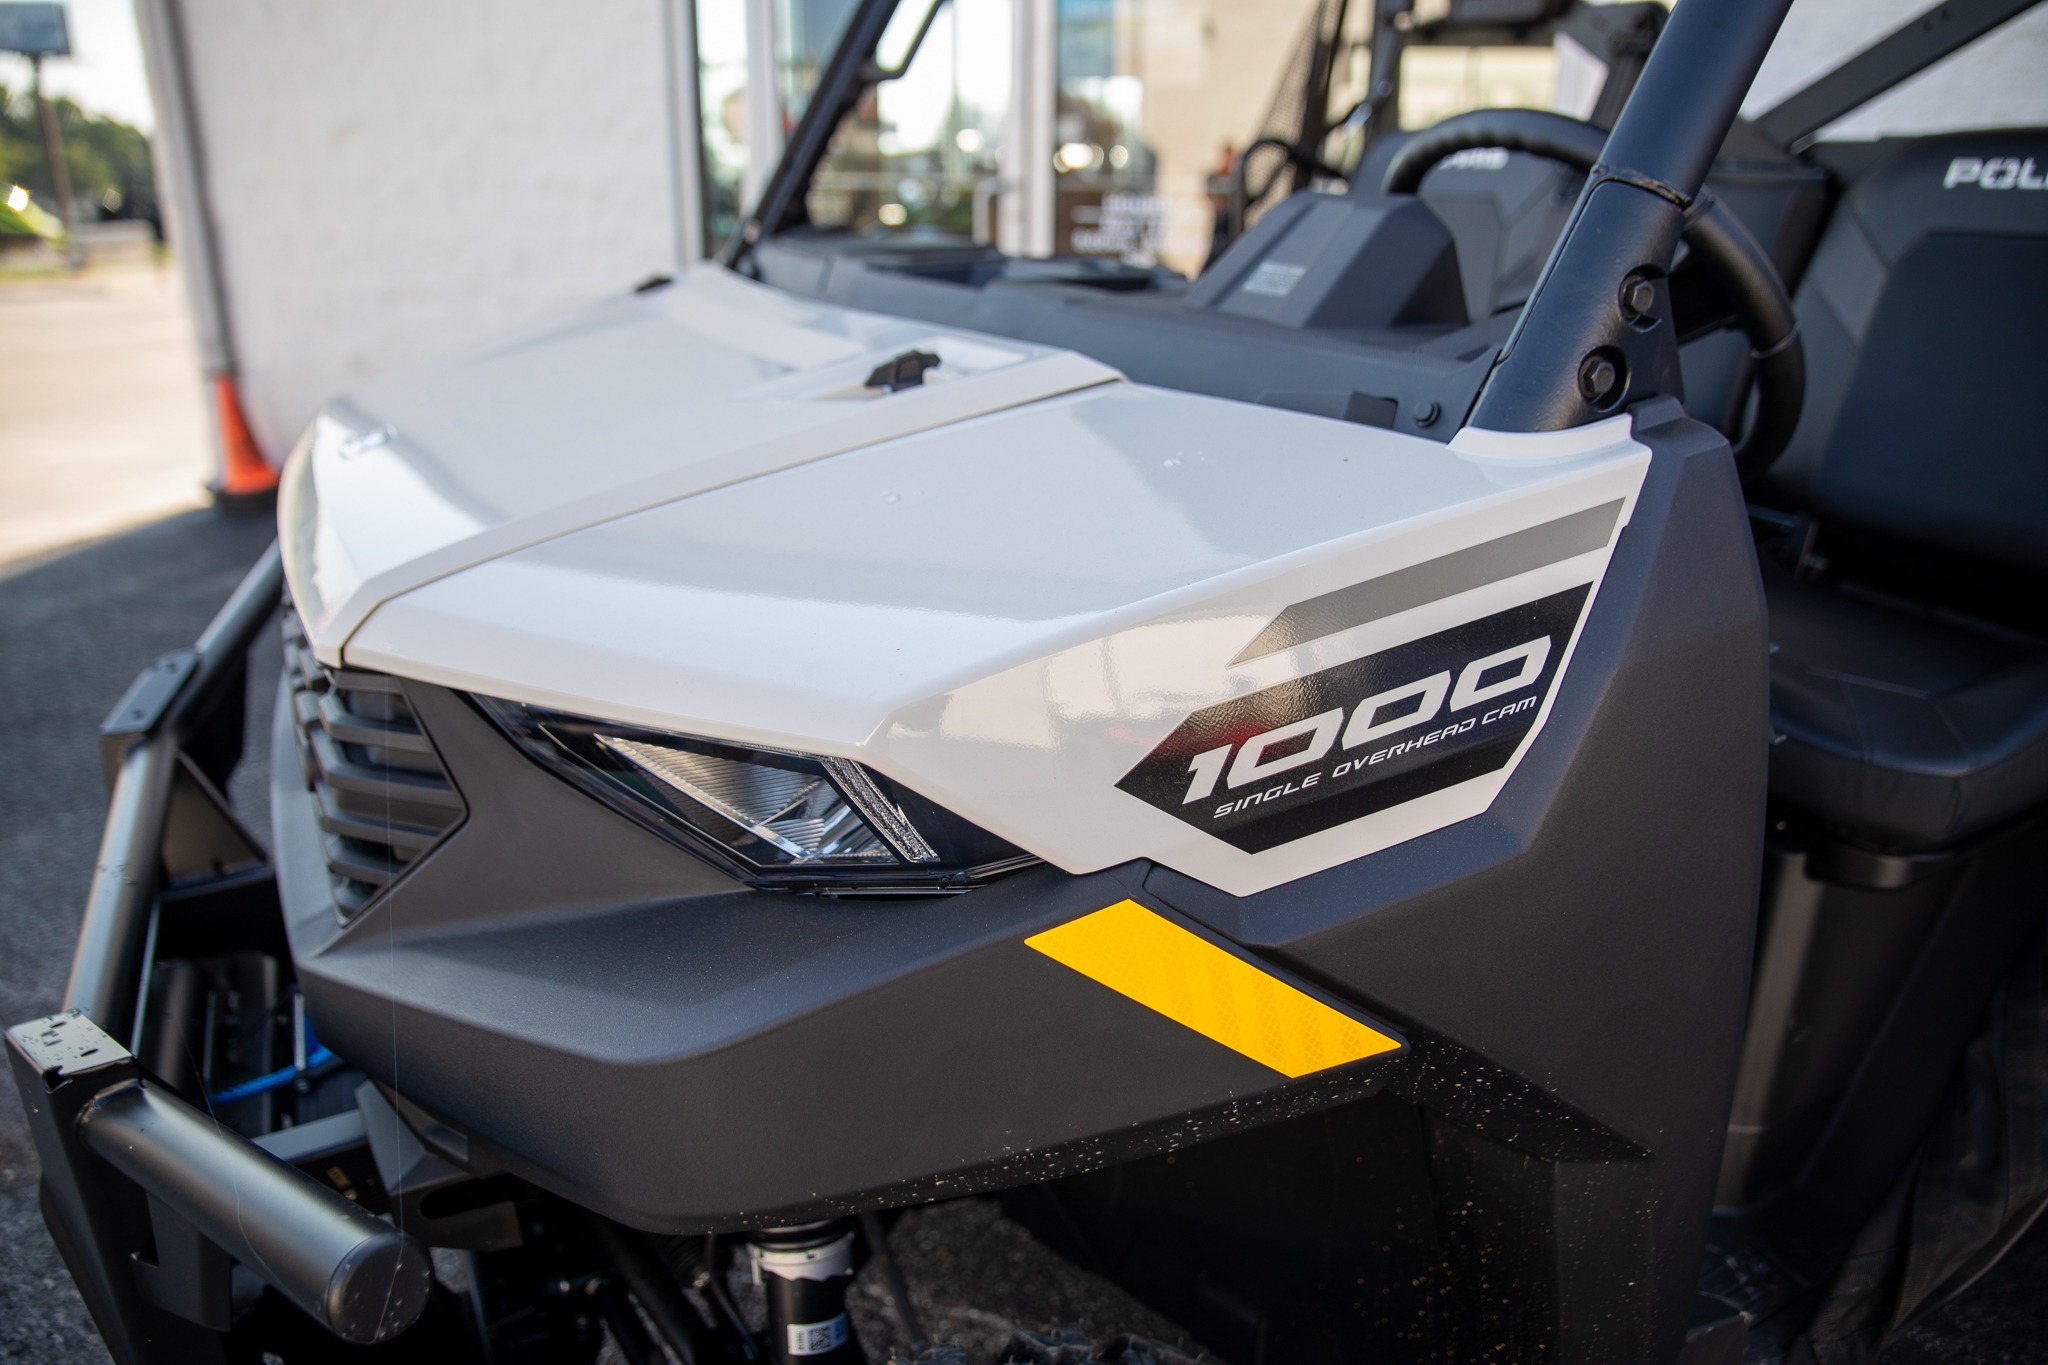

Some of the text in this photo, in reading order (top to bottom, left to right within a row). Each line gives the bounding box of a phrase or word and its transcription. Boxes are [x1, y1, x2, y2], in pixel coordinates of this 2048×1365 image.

[1942, 157, 2048, 190] POL
[1182, 635, 1552, 805] 1000
[1213, 696, 1538, 819] SINGLE OVERHEAD CAM
